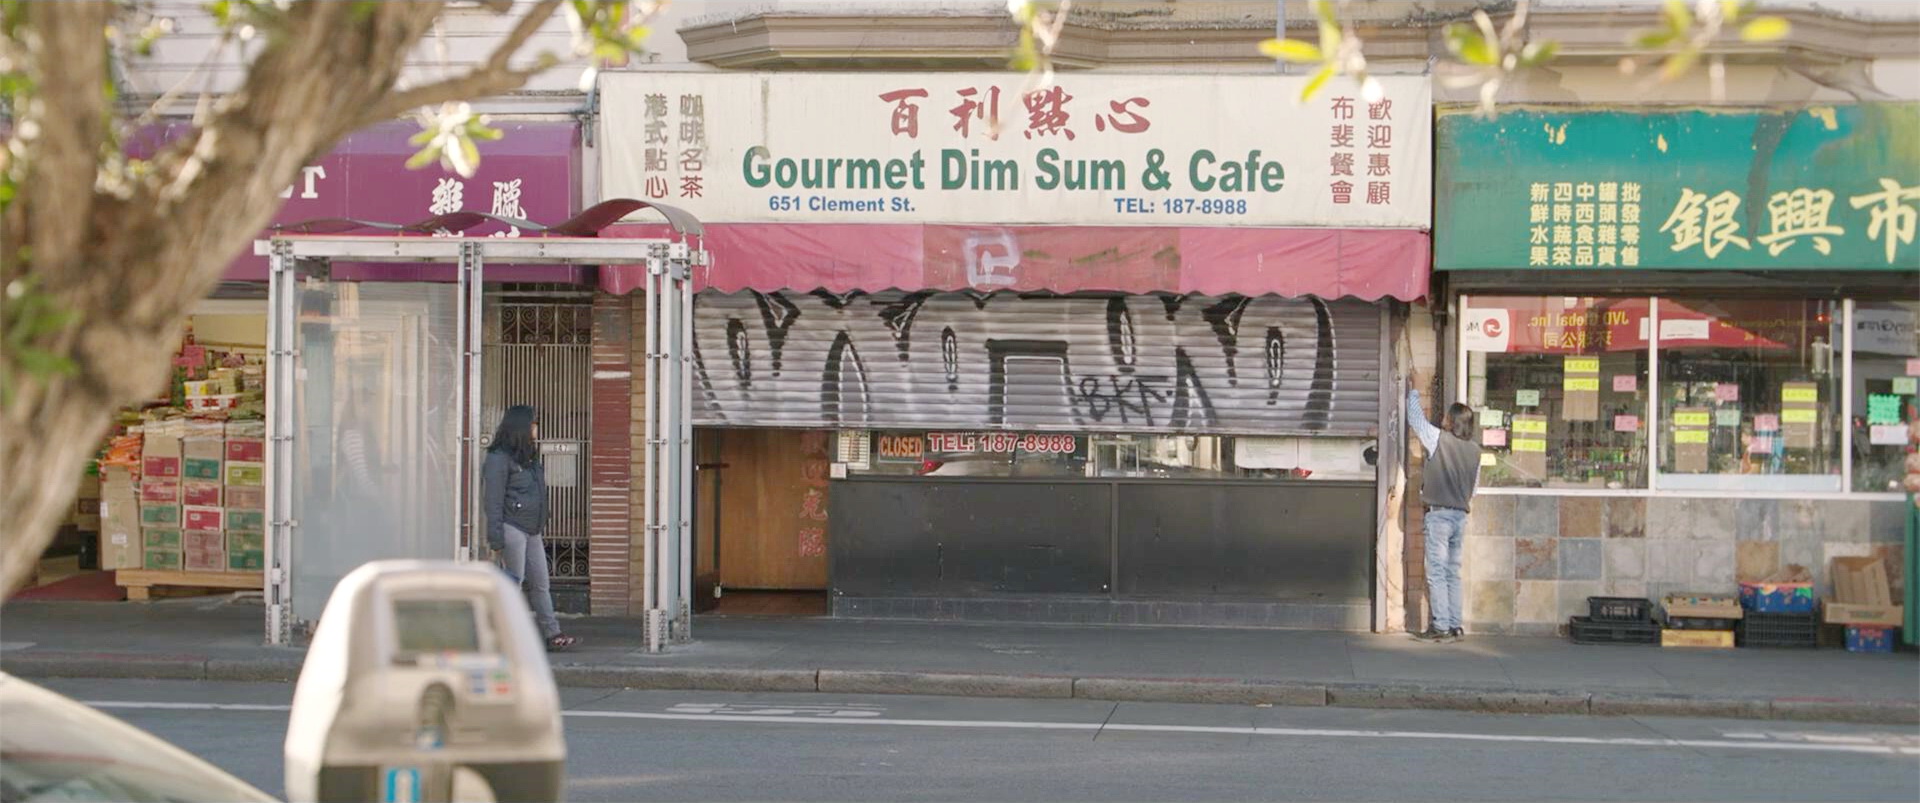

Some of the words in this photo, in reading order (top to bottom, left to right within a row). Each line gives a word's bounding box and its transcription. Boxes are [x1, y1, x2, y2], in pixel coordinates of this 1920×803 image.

[644, 93, 668, 198] 港式點心
[679, 93, 704, 198] 咖啡名茶
[878, 85, 1151, 141] 百利點心
[1330, 96, 1354, 204] 布斐餐會
[1366, 97, 1392, 205] 歡迎惠顧
[742, 145, 925, 190] Gourmet
[941, 148, 1019, 191] Dim
[1035, 147, 1126, 191] Sum
[1141, 147, 1172, 191] &
[1188, 148, 1286, 192] Cafe
[768, 195, 800, 211] 651
[808, 196, 886, 212] Clement
[890, 197, 916, 212] St.
[1113, 198, 1155, 213] TEL:
[1163, 198, 1247, 214] 187-8988
[1530, 182, 1549, 266] 新鮮水果
[1575, 182, 1595, 266] 中西食品
[1598, 181, 1618, 267] 罐頭雜貨
[1620, 181, 1641, 266] 批發零售
[1659, 178, 1920, 264] 銀興市
[879, 436, 922, 458] CLOSED
[927, 432, 976, 452] TEL:
[980, 434, 1076, 453] 187-8988
